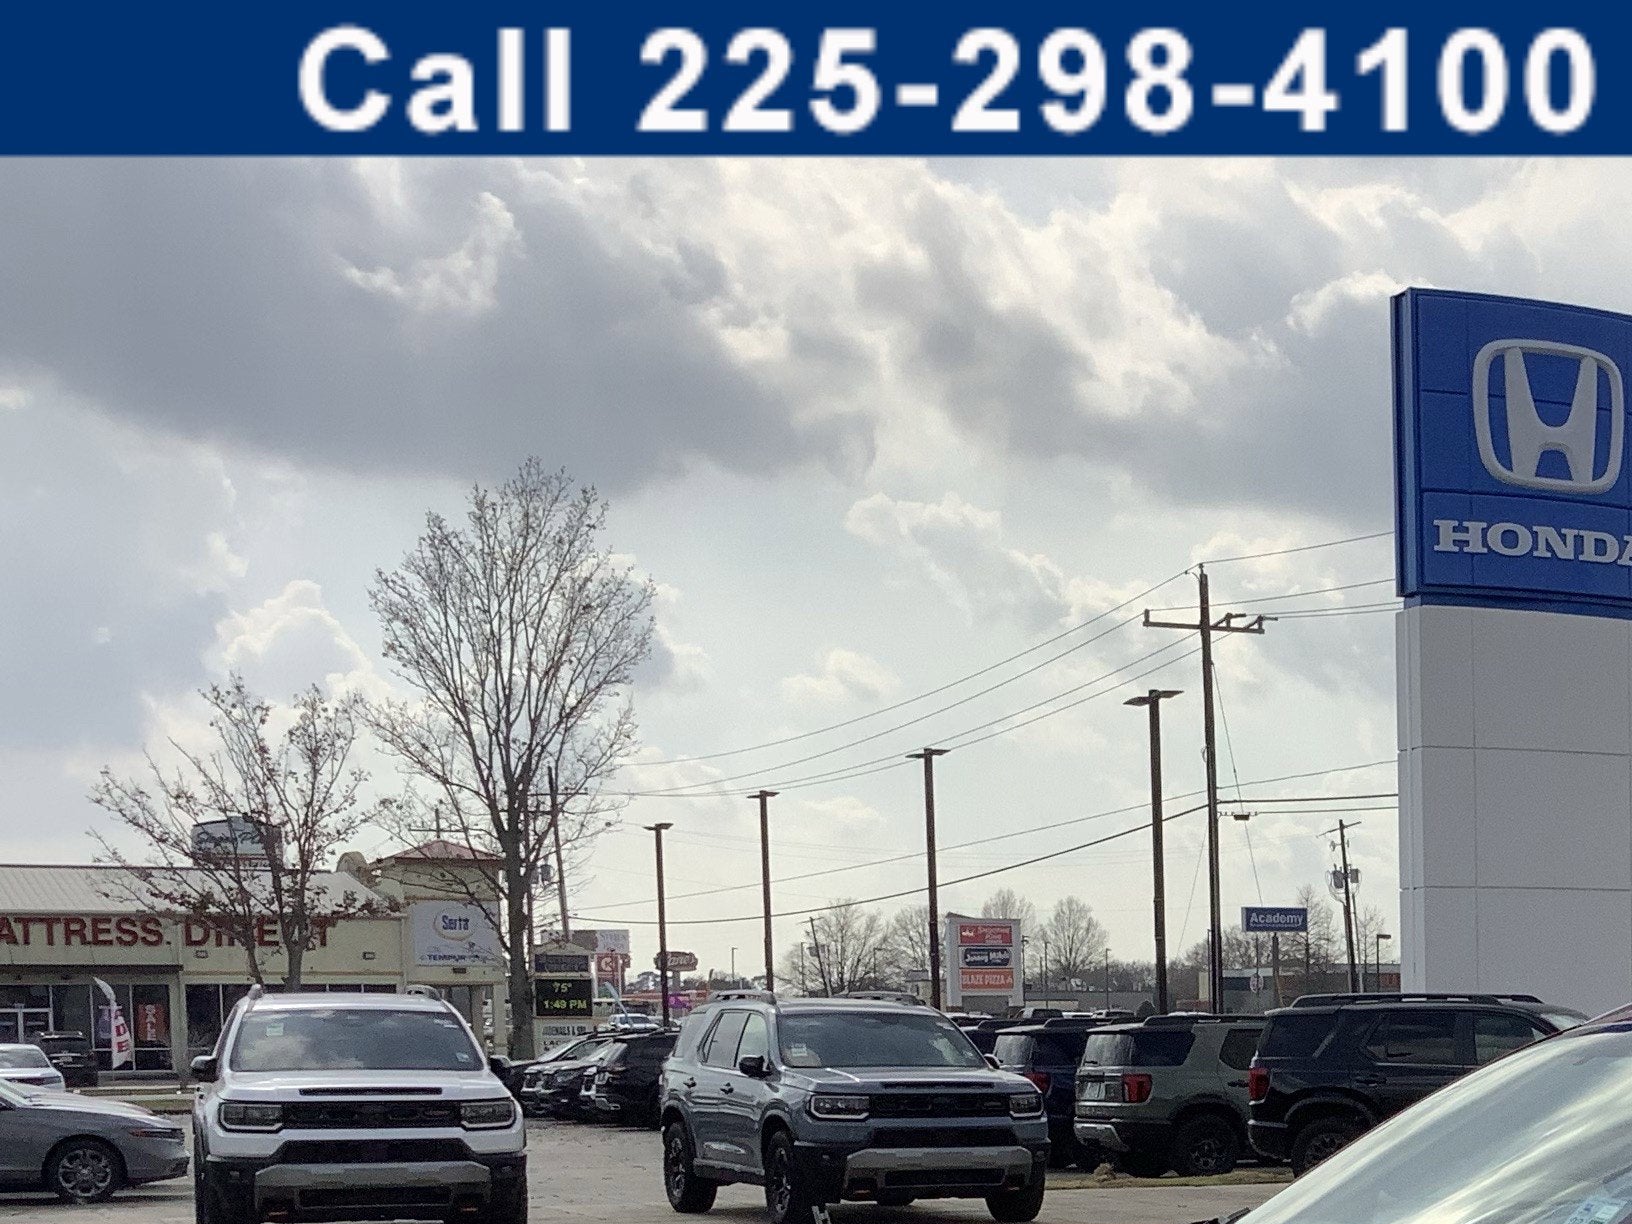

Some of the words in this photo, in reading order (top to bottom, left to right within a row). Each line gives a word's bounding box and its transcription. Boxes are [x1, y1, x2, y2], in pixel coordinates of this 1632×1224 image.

[441, 914, 470, 931] Serta
[1249, 912, 1304, 926] Academy
[543, 999, 567, 1009] 1:49
[569, 999, 587, 1009] PM
